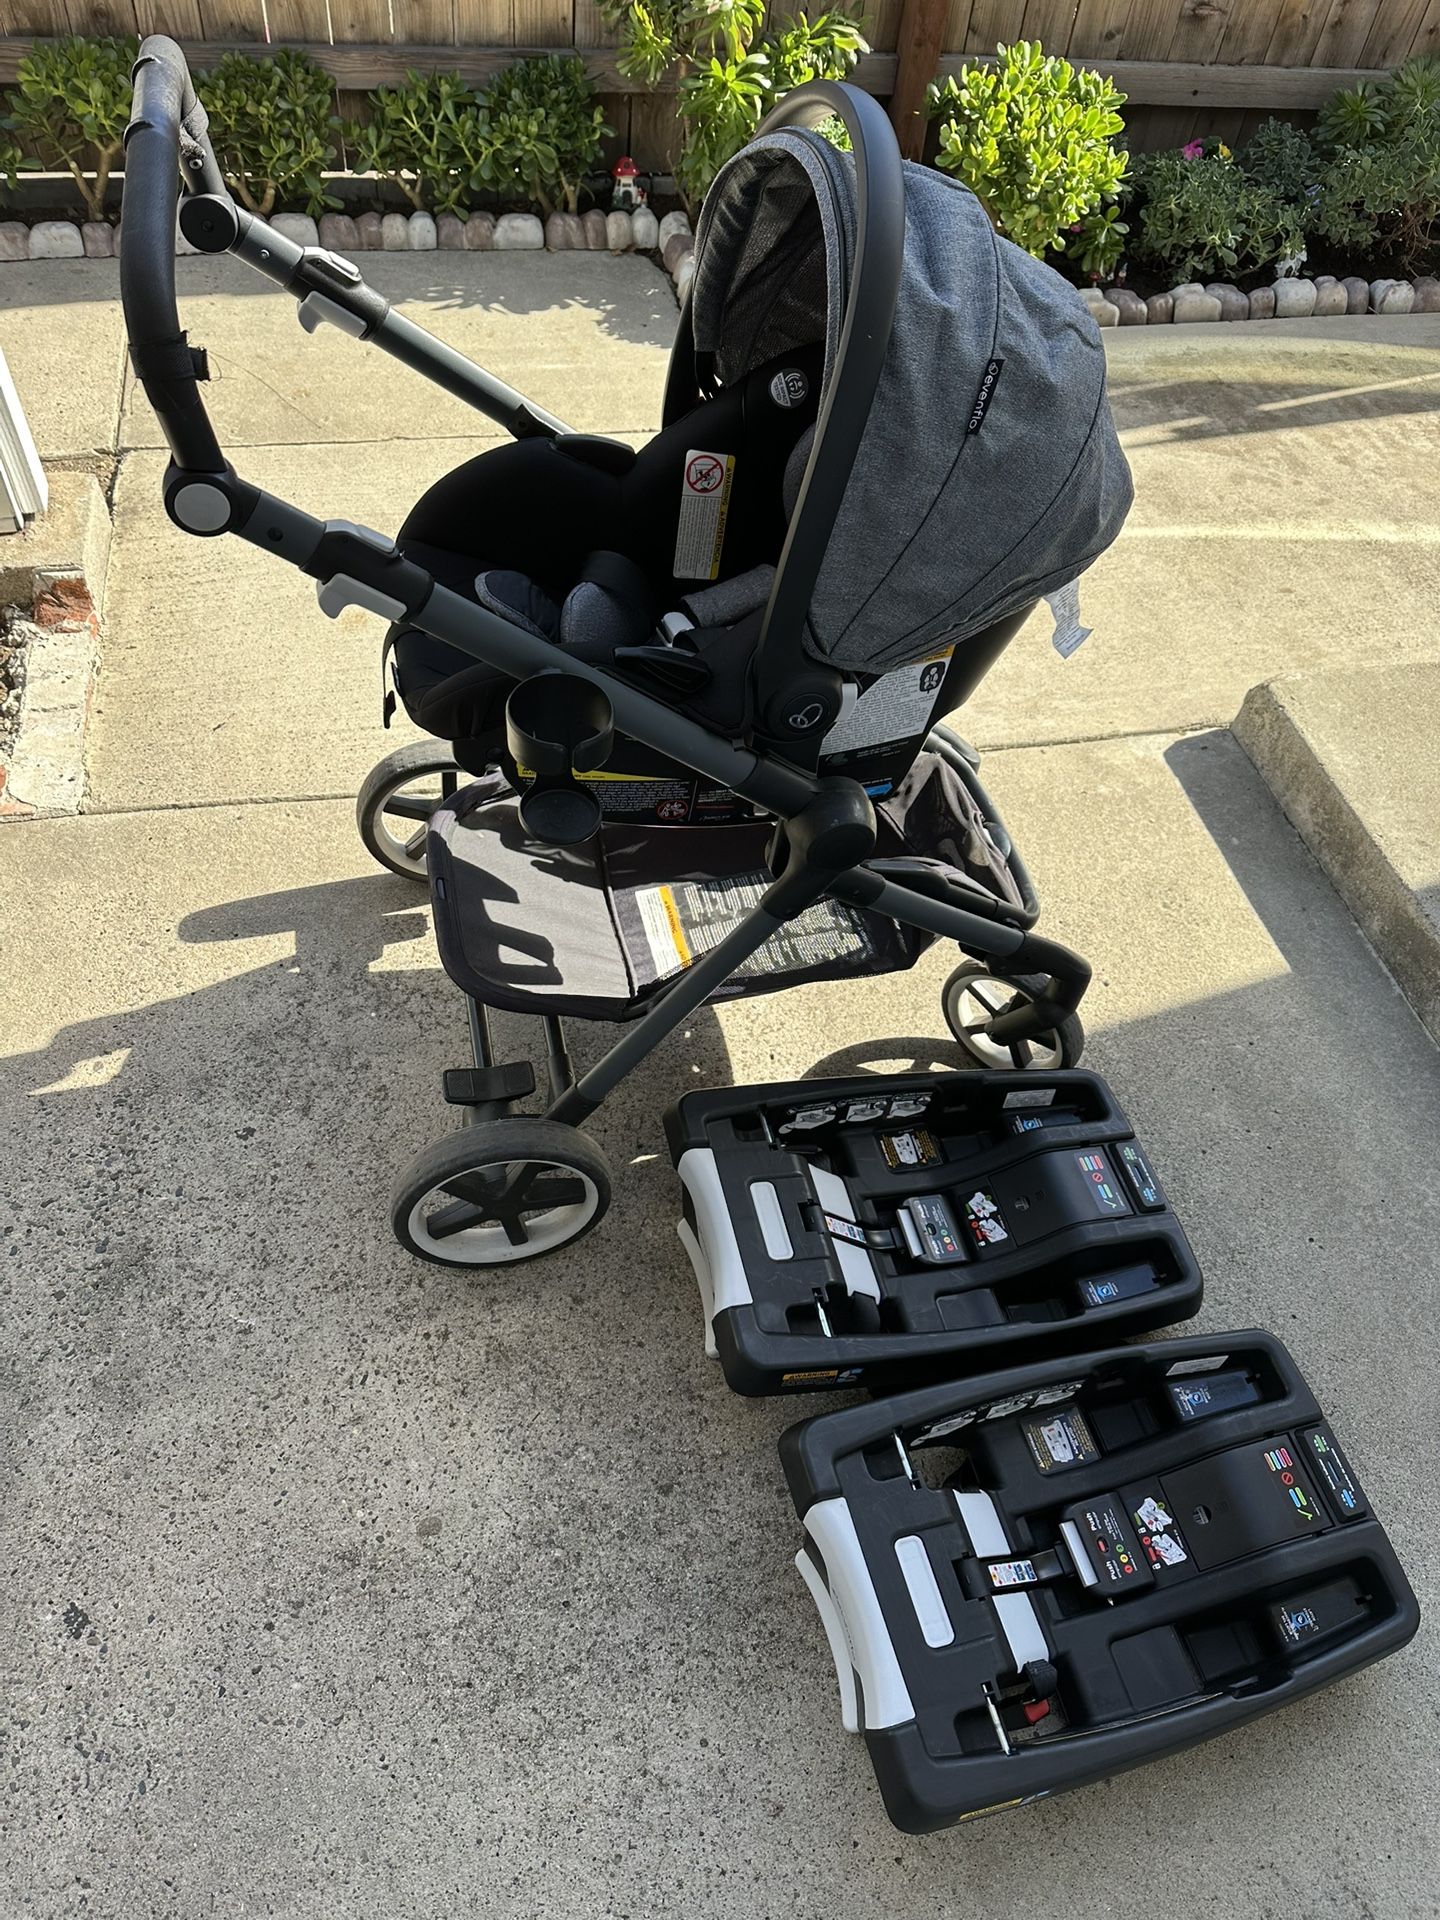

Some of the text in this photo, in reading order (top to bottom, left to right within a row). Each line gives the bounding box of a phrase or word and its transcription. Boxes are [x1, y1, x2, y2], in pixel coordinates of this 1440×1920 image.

[969, 375, 993, 430] evenflo
[714, 473, 733, 563] WARNING ADVERTENCIA
[665, 904, 677, 934] WARNING
[1086, 1512, 1097, 1531] Push
[1106, 1560, 1117, 1580] Push
